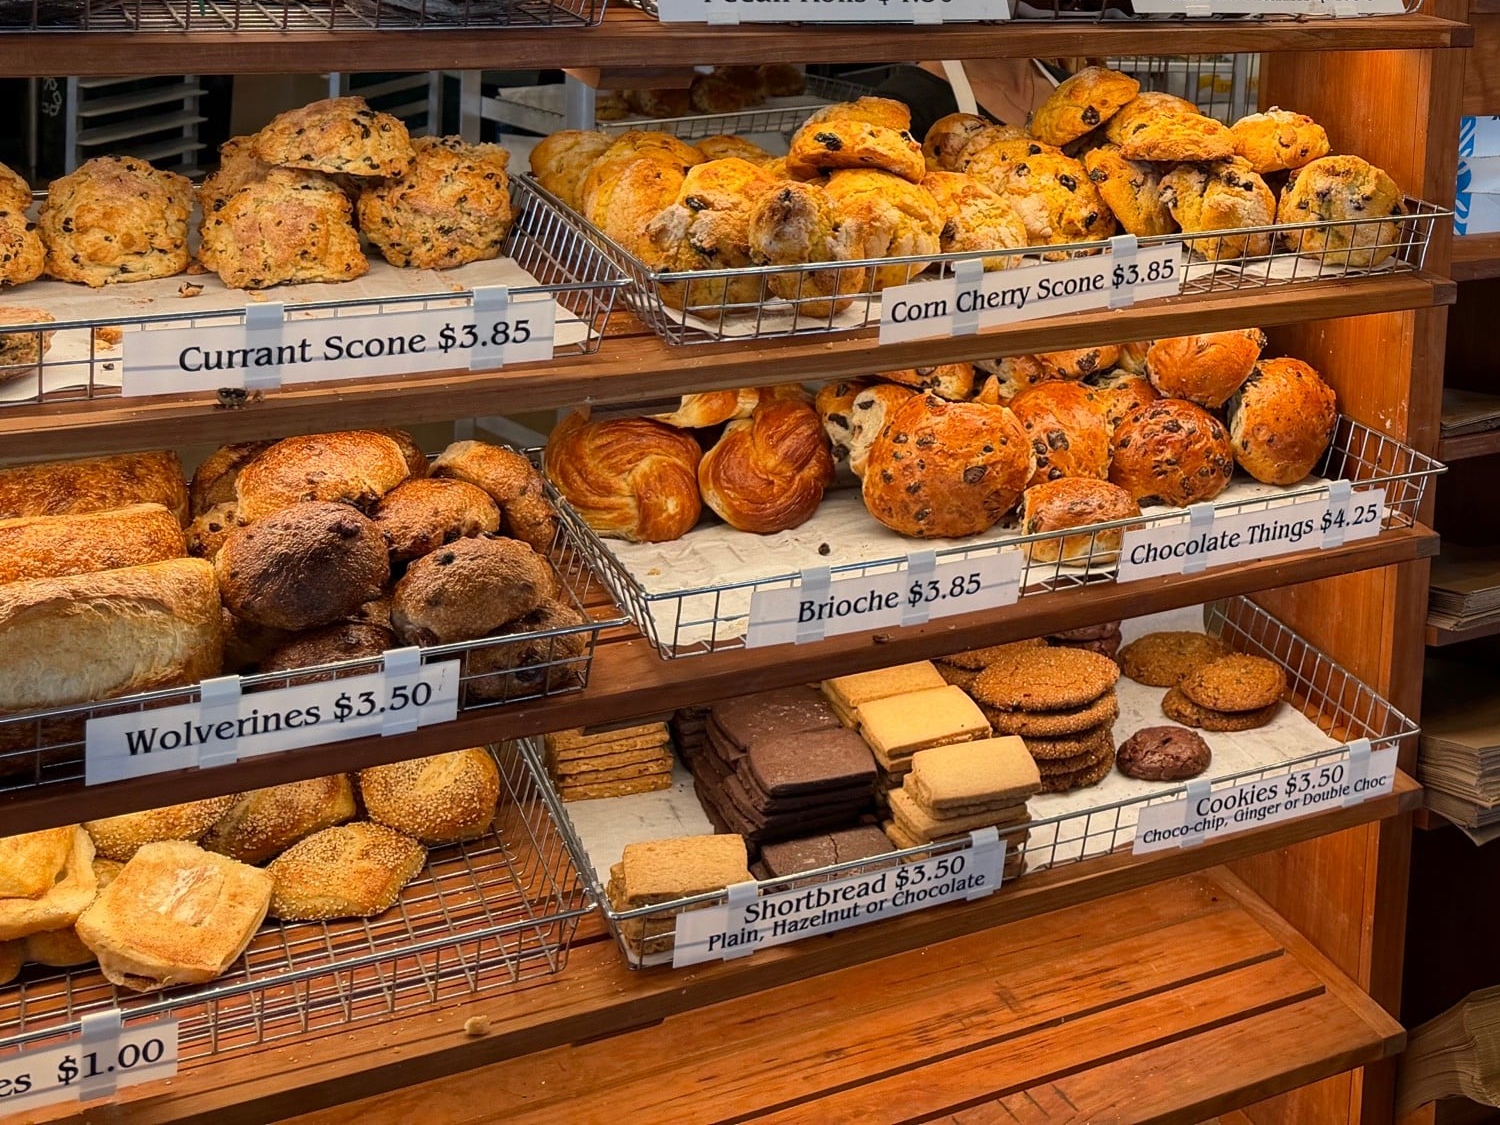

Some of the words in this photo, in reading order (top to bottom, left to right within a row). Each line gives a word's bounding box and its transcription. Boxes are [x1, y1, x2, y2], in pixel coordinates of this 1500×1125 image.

[891, 300, 947, 324] Corn
[955, 285, 1031, 313] Cherry
[1037, 273, 1105, 301] Scone
[1111, 258, 1175, 289] $3.85
[178, 339, 312, 373] Currant
[323, 333, 427, 361] Scone
[438, 319, 532, 350] $3.85
[1129, 529, 1241, 566] Chocolate
[1247, 517, 1315, 549] Things
[1319, 502, 1378, 533] $4.25
[797, 588, 899, 624] Brioche
[907, 571, 983, 609] $3.85
[125, 704, 321, 756] Wolverines
[333, 681, 432, 723] $3.50
[1143, 815, 1228, 844] Choco-chip,
[1234, 802, 1281, 823] Ginger
[1284, 799, 1300, 810] or
[1302, 784, 1350, 806] Double
[1354, 775, 1386, 792] Choc
[1196, 783, 1278, 817] Cookies
[1284, 764, 1344, 797] $3.50
[708, 927, 765, 952] Plain,
[772, 904, 860, 937] Hazelnut
[866, 898, 888, 914] or
[892, 873, 985, 907] Chocolate
[743, 874, 886, 924] Shortbread
[895, 855, 965, 890] $3.50
[57, 1038, 165, 1085] $1.00
